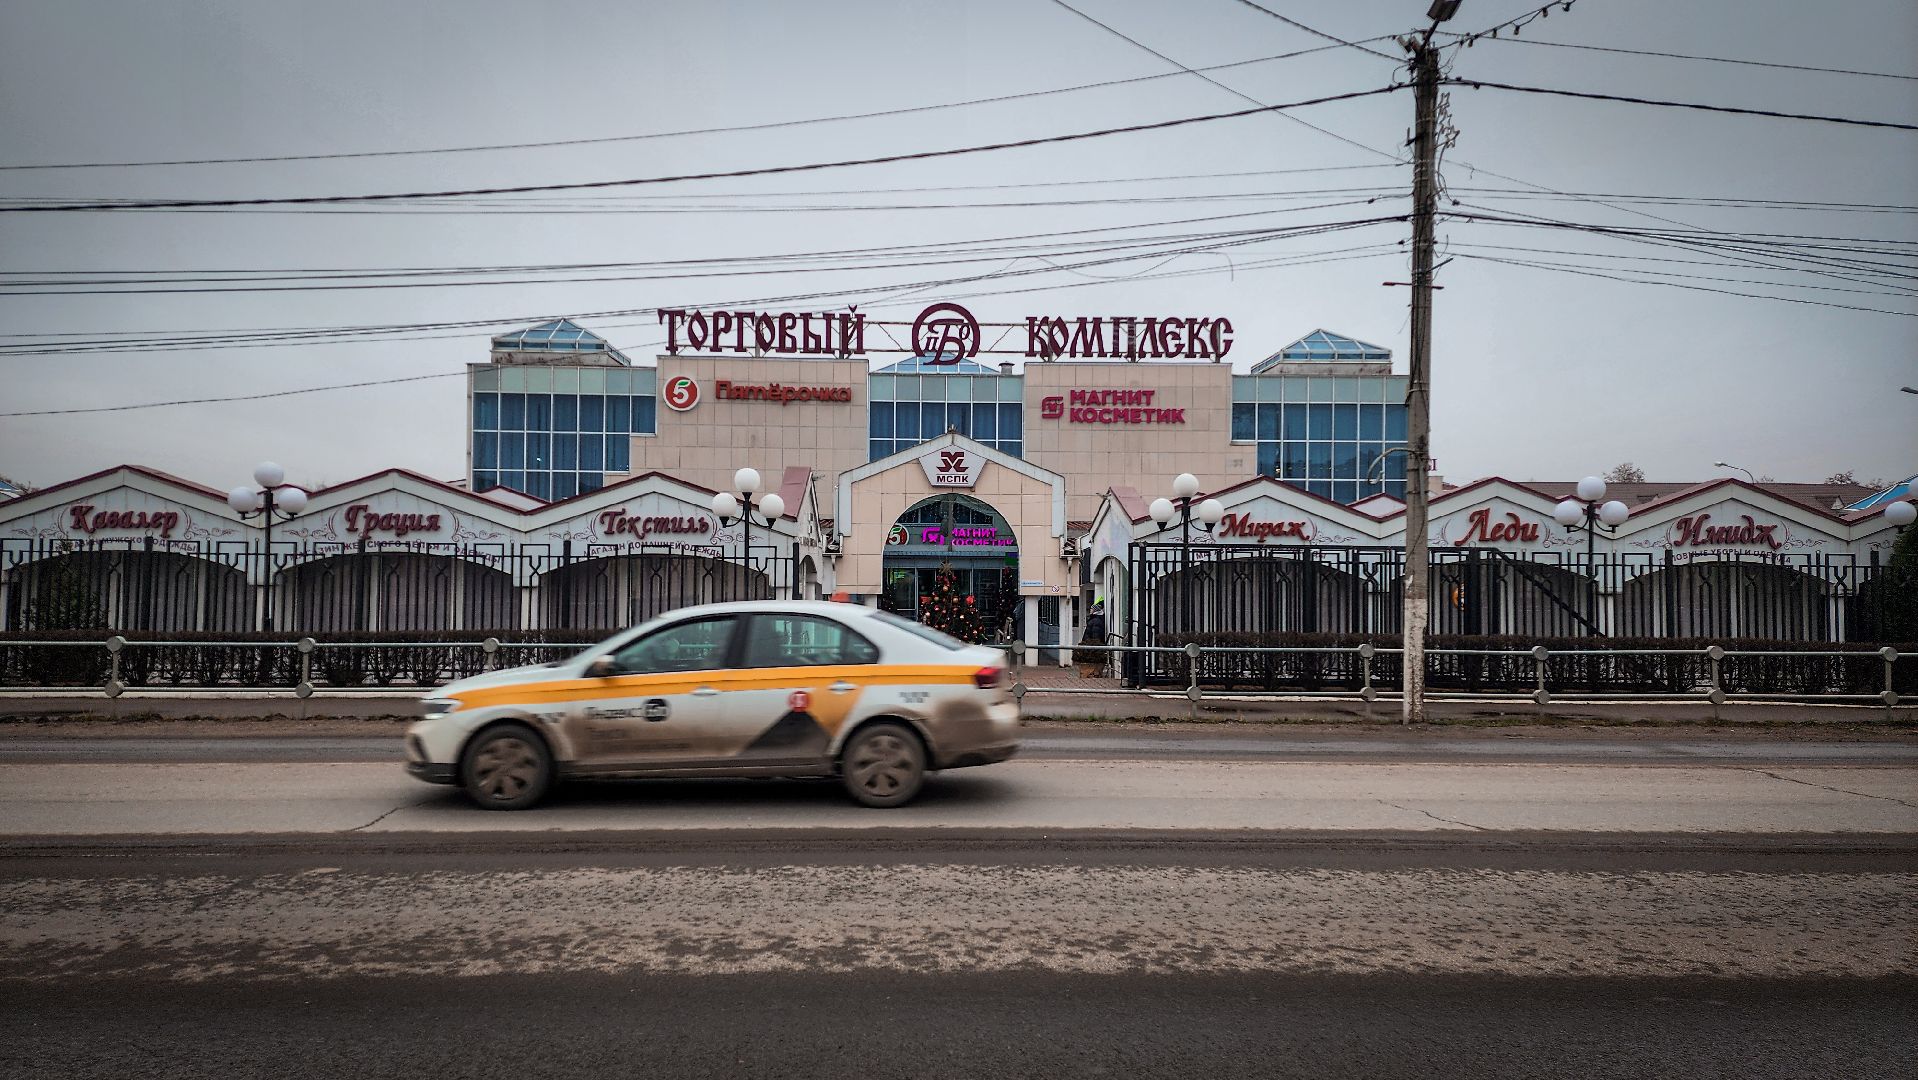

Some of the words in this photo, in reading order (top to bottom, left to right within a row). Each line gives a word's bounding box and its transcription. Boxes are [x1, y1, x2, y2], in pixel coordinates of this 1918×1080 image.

[657, 304, 866, 355] ТОРГОВЫЙ
[1025, 316, 1233, 359] КОМПЛЕКС
[716, 380, 853, 406] Пятёрочка
[1069, 389, 1155, 406] МАГНИТ
[1069, 407, 1186, 424] КОСМЕТИК
[936, 475, 969, 483] МСПК
[70, 505, 178, 538] Кавалер
[344, 504, 441, 539] Грация
[600, 507, 710, 540] Текстиль
[1219, 511, 1311, 543] Мираж
[1454, 508, 1540, 547] Леди
[1673, 513, 1783, 550] Имидж
[343, 540, 402, 551] ЖЕСКОГО
